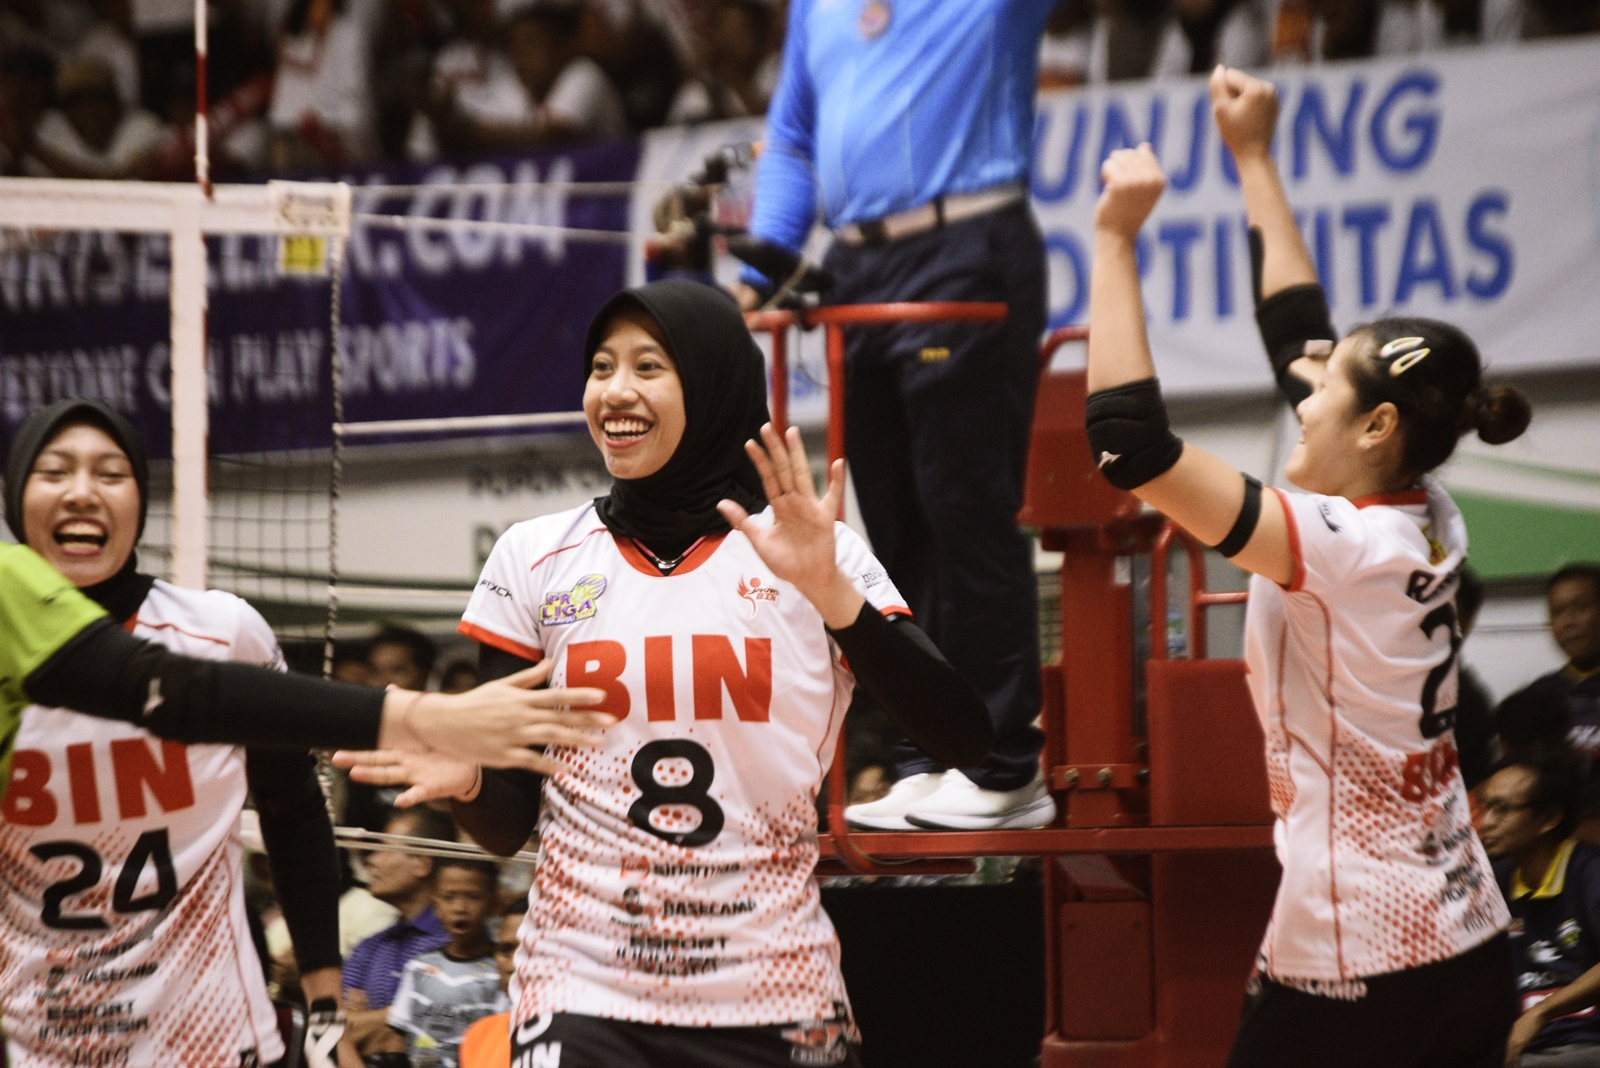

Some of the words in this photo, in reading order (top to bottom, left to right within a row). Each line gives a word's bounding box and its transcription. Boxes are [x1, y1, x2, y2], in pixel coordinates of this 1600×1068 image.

[1045, 188, 1515, 330] OTIITAS
[542, 600, 593, 619] LIGA
[565, 633, 773, 724] BIN
[0, 737, 196, 827] BIN
[628, 738, 725, 847] 8
[28, 827, 178, 931] 24
